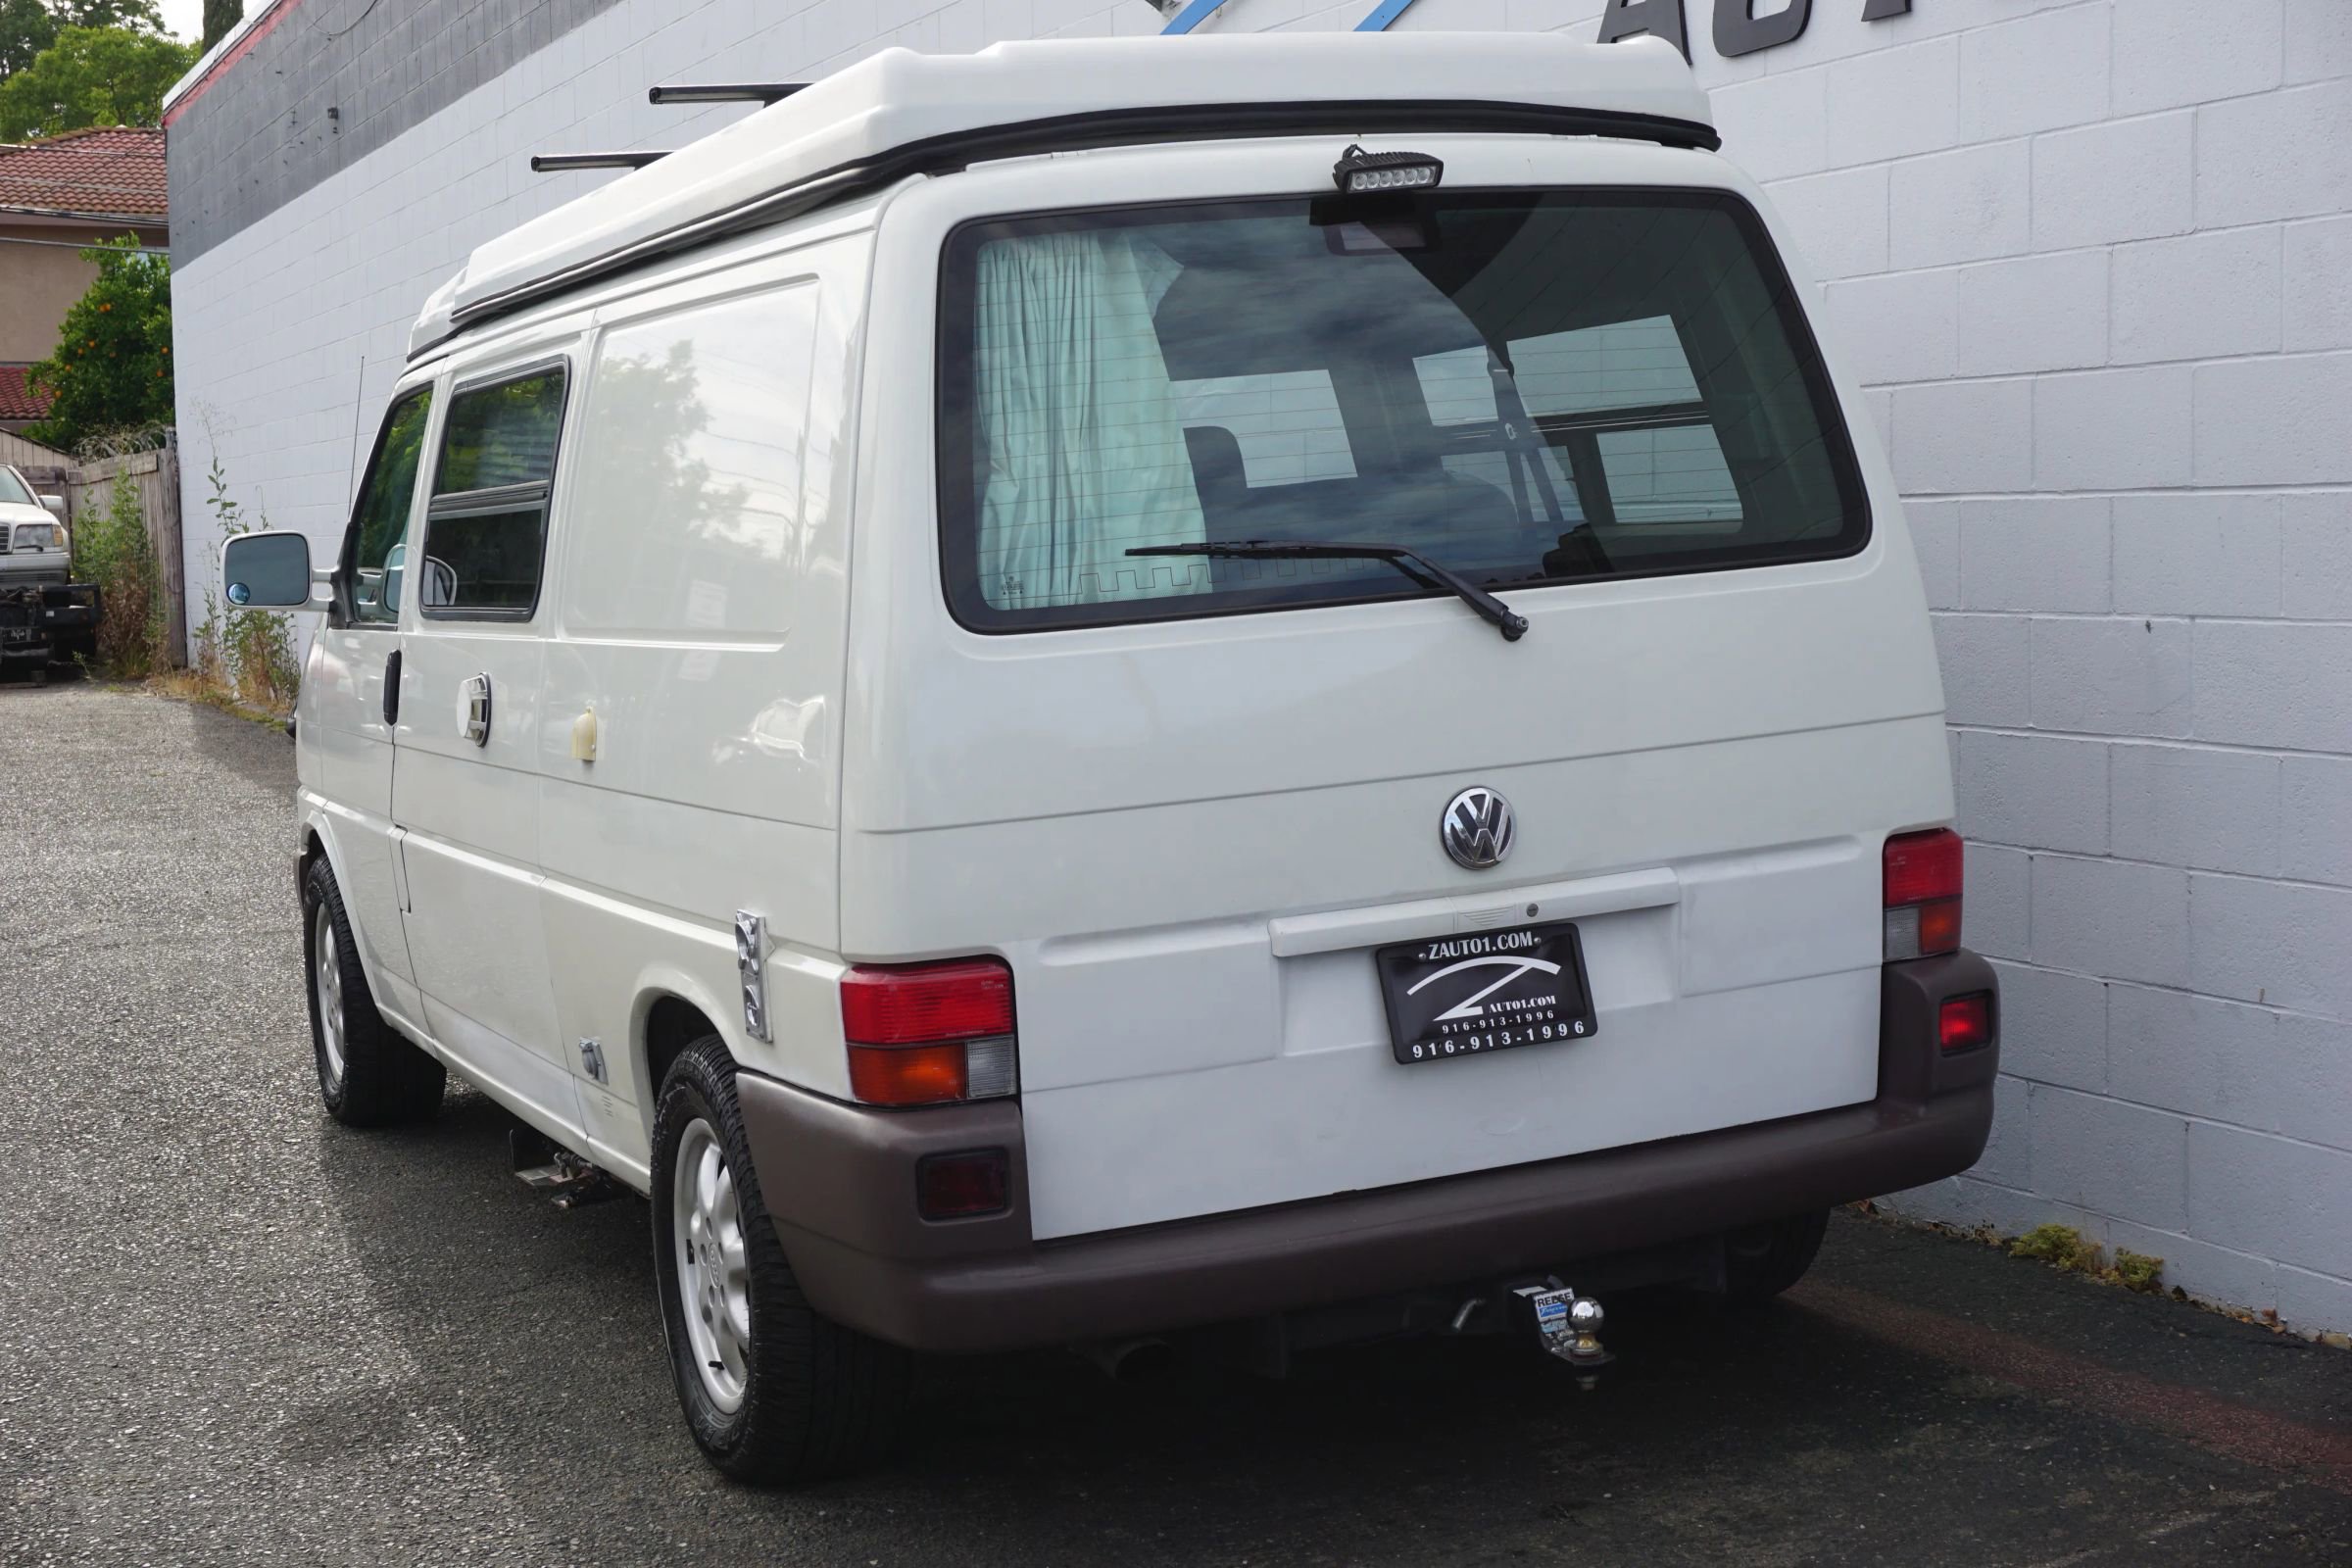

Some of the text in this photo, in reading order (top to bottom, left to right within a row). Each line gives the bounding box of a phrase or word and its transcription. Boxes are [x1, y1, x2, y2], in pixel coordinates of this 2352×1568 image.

[1429, 931, 1533, 960] ZAUTO1.COM
[1489, 995, 1556, 1013] AUTO1.COM
[1442, 1010, 1554, 1034] 916-913-1996
[1412, 1021, 1585, 1058] 916-913-1996
